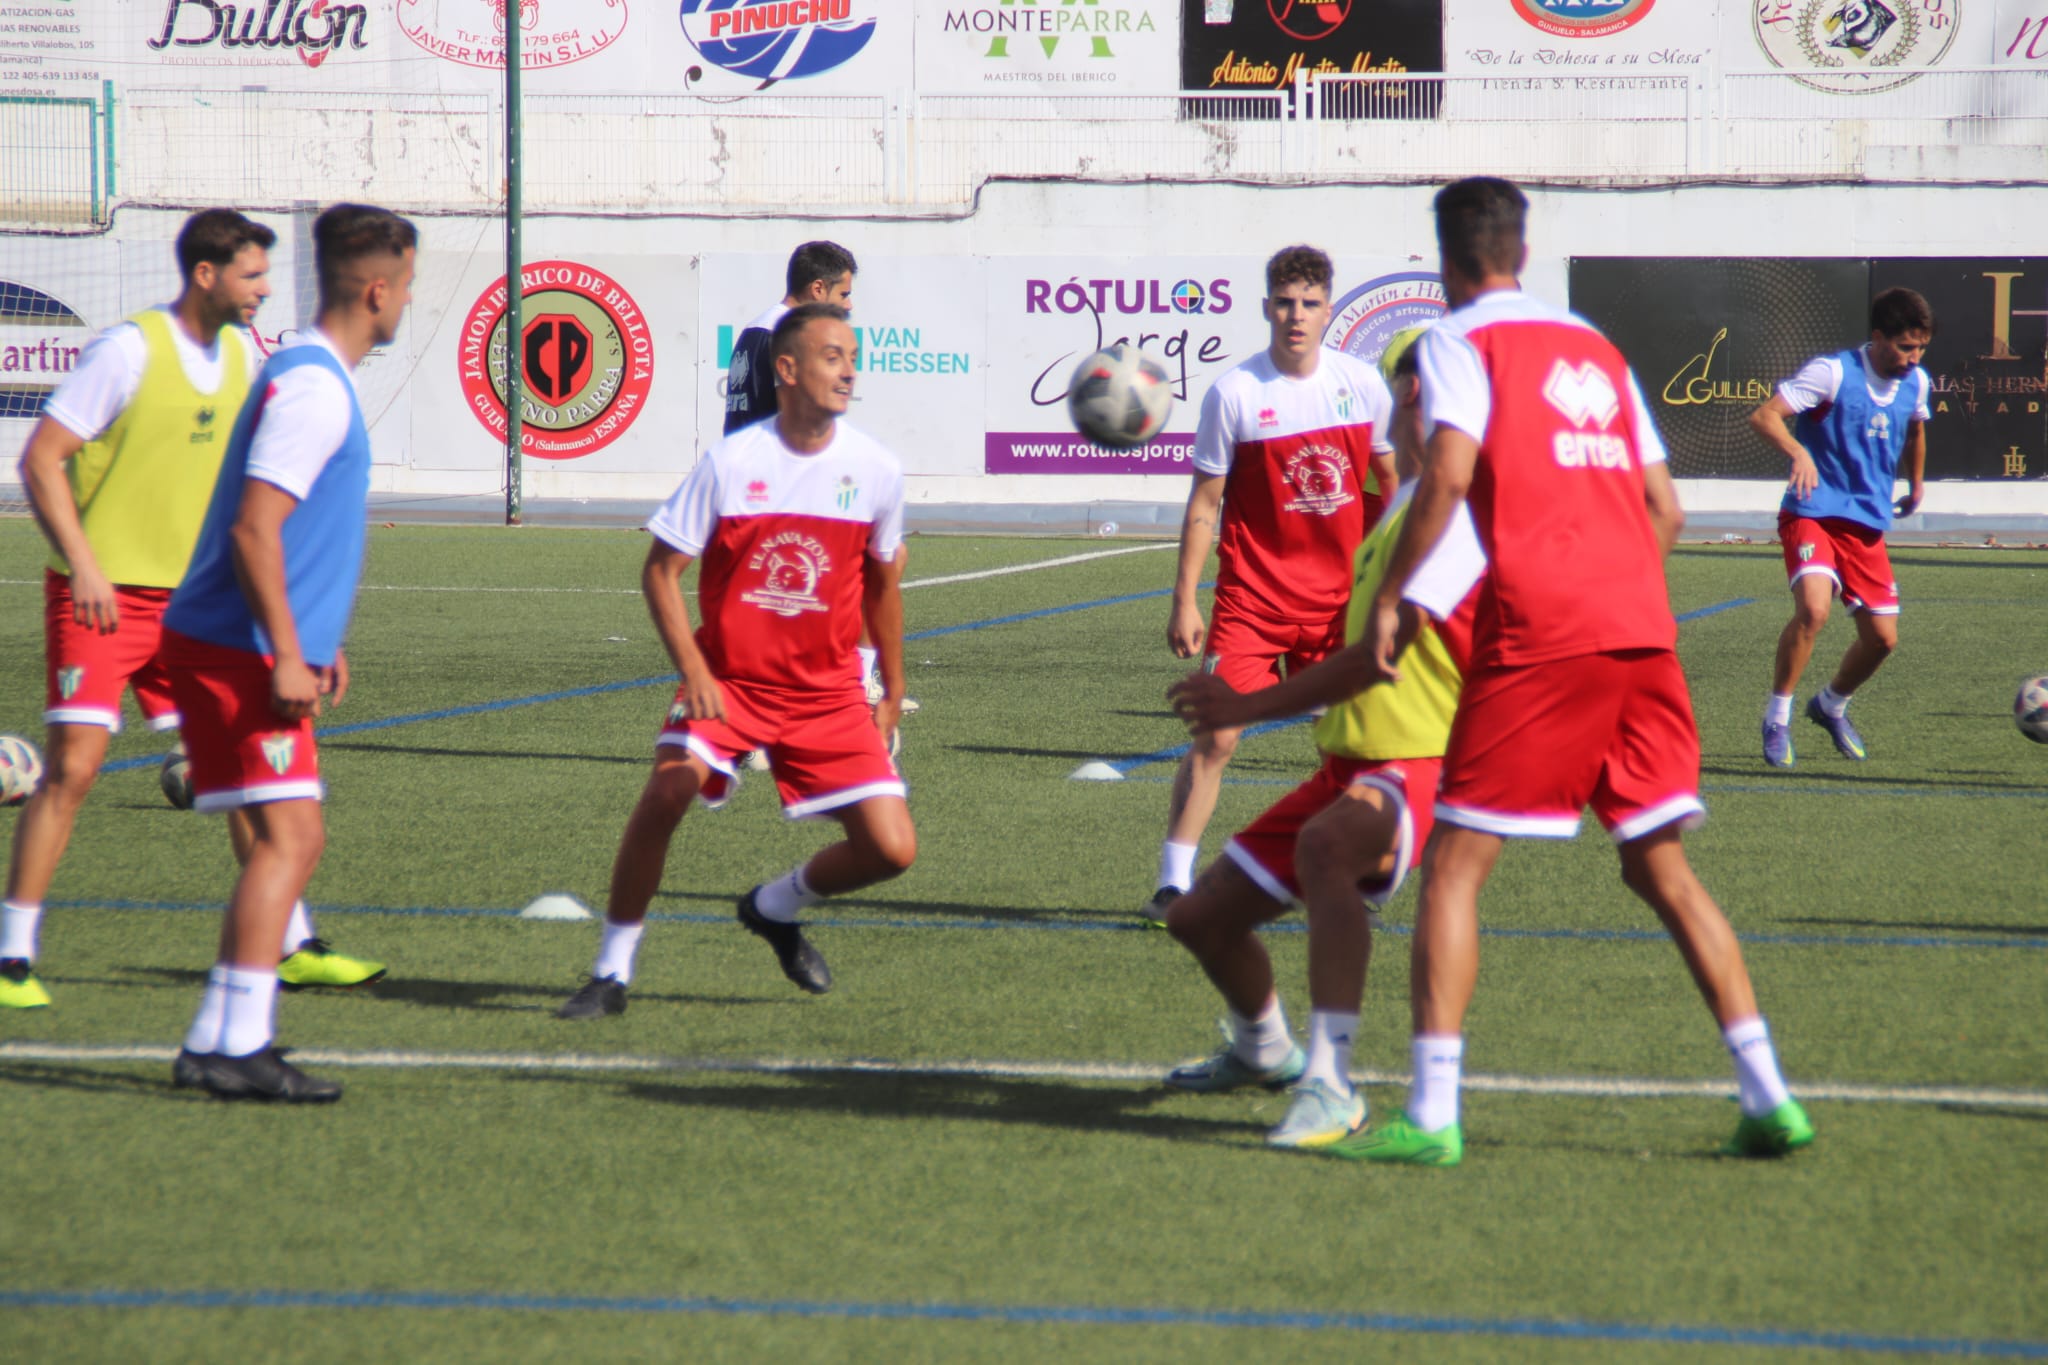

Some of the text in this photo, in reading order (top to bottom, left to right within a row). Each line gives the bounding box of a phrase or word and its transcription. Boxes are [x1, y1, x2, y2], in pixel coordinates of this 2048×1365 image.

[18, 24, 81, 33] RENOVABLES
[944, 9, 1156, 32] MONTEPARRA
[1580, 19, 1629, 36] SALAMANCA
[408, 26, 470, 60] JAVIER
[476, 48, 552, 66] MATÍN
[1509, 50, 1523, 65] la
[1533, 49, 1599, 65] Dehesa
[1605, 54, 1614, 65] a
[1622, 54, 1639, 65] su
[1048, 73, 1066, 81] DEL
[1209, 50, 1278, 88] Antonio
[1395, 305, 1442, 319] artesan
[465, 267, 651, 381] JAMON IBRICO DE BELLOTA
[869, 327, 920, 348] VAN
[0, 336, 80, 373] artín
[869, 352, 969, 374] HESSEN
[567, 365, 622, 423] PARRA
[535, 434, 596, 452] (Salamanca)
[593, 392, 639, 440] ESPAÑA
